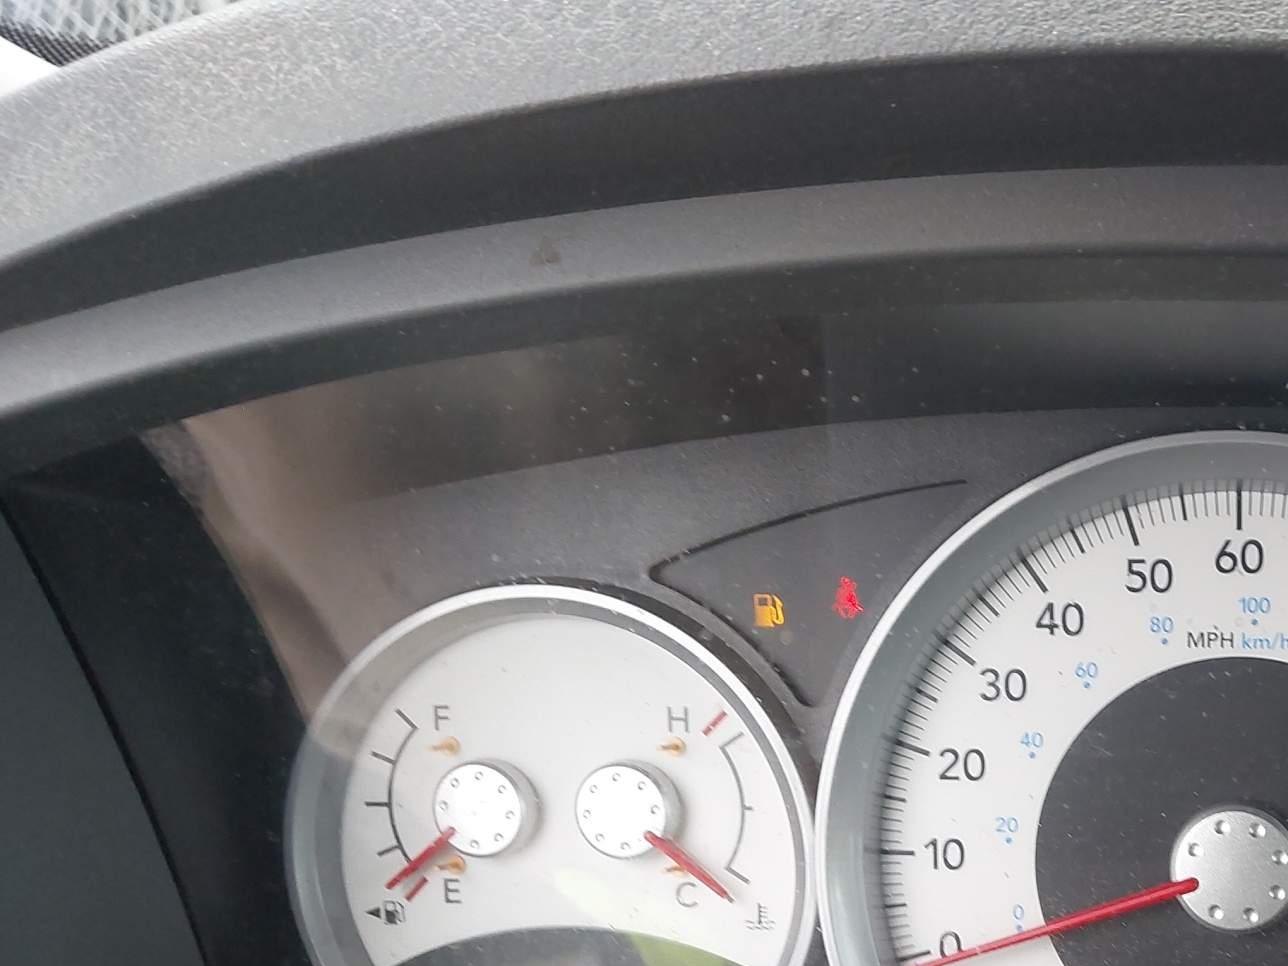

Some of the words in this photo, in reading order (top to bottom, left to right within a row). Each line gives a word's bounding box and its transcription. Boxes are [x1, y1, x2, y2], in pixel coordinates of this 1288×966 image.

[1216, 540, 1263, 573] 60
[1126, 559, 1172, 593] 50
[1240, 598, 1270, 613] 100
[1036, 603, 1083, 636] 40
[1151, 617, 1173, 632] 80
[1188, 632, 1233, 648] MPH
[1076, 663, 1097, 678] 60
[980, 669, 1026, 701] 30
[434, 705, 449, 730] F
[668, 707, 689, 733] H
[1021, 733, 1043, 748] 40
[940, 749, 985, 781] 20
[996, 817, 1018, 832] 20
[925, 839, 964, 870] 10
[444, 879, 461, 903] E
[676, 882, 697, 907] C
[1013, 905, 1024, 920] 0
[940, 932, 961, 958] 0
